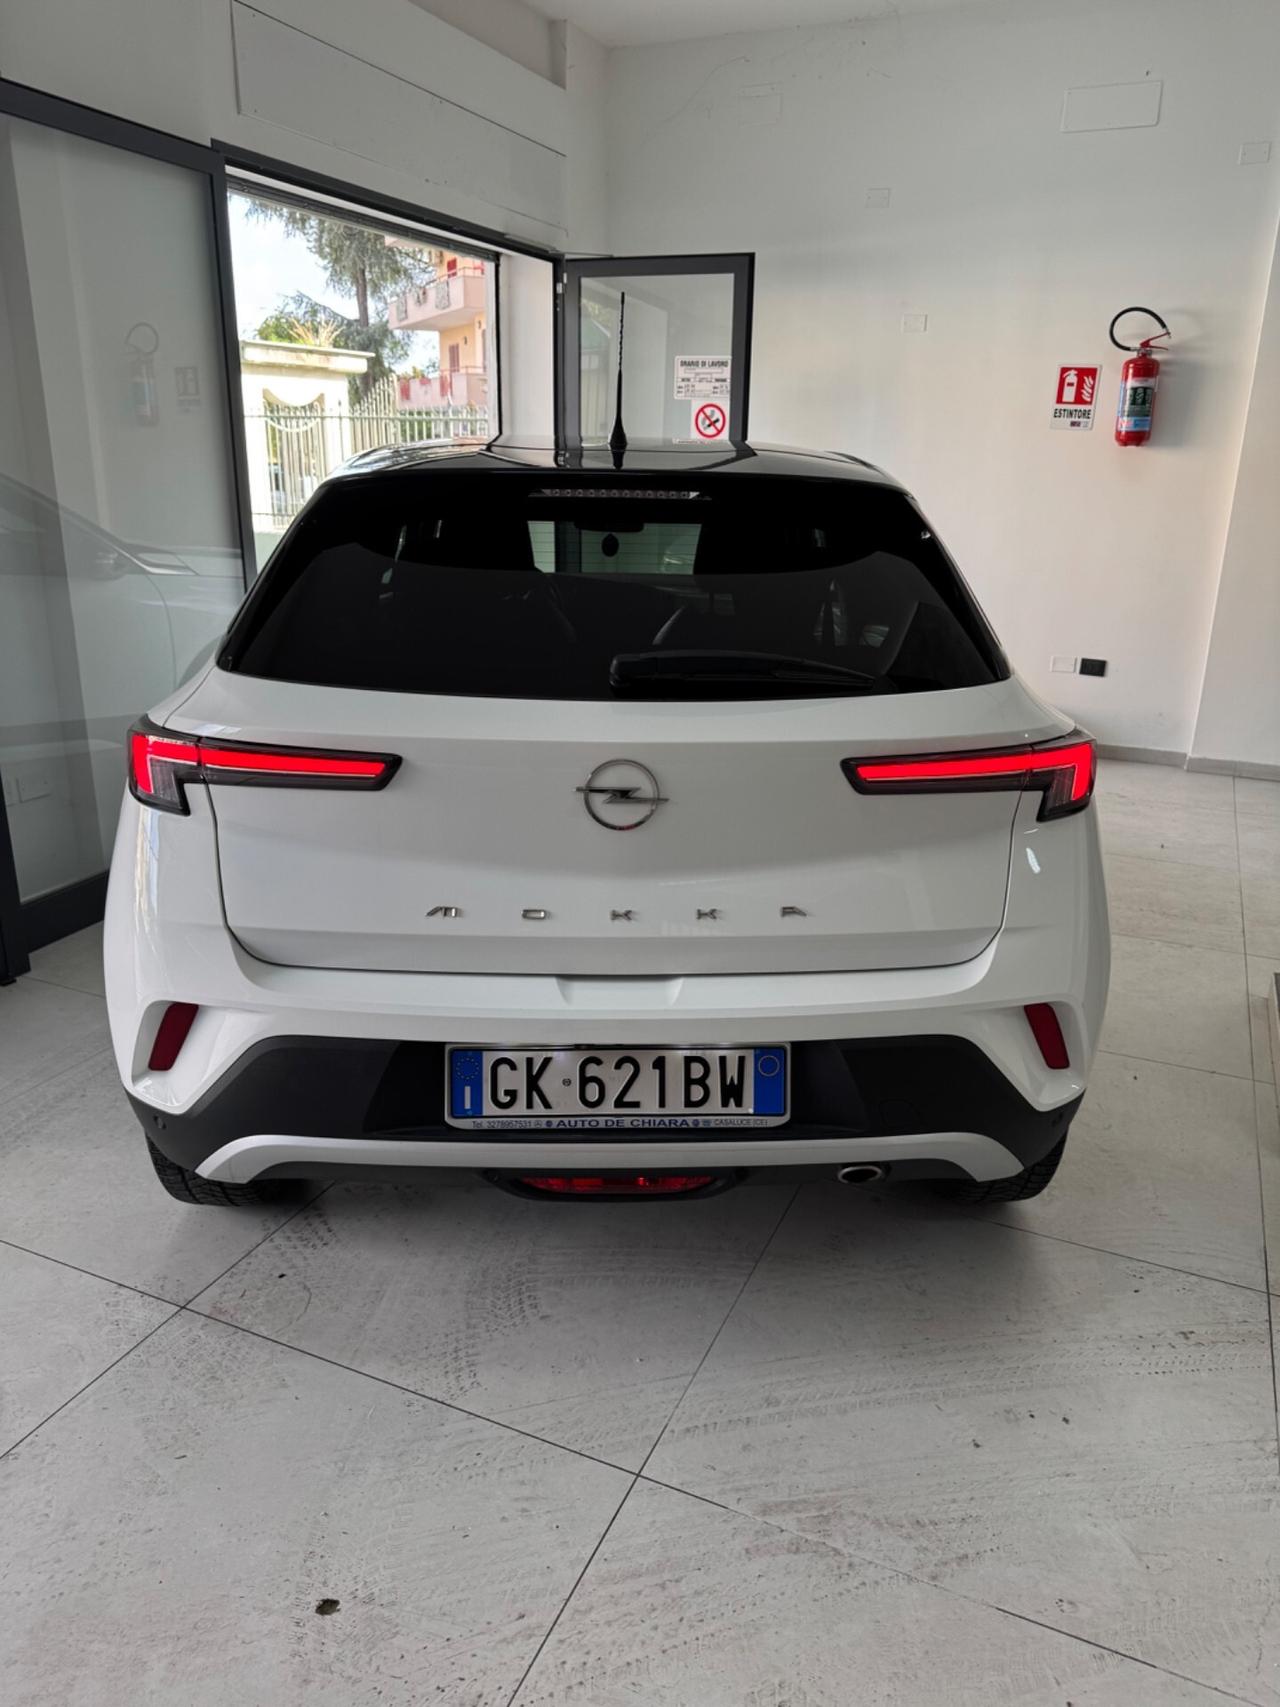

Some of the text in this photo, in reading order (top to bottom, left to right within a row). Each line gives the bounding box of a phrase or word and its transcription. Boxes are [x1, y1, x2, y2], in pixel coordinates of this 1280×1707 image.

[1053, 409, 1092, 419] ESTINTORE
[490, 1055, 746, 1110] GK 621BW
[556, 1119, 600, 1128] AUTO
[604, 1119, 624, 1128] DE
[630, 1118, 689, 1128] CHIARA
[713, 1118, 752, 1127] CASALUCE
